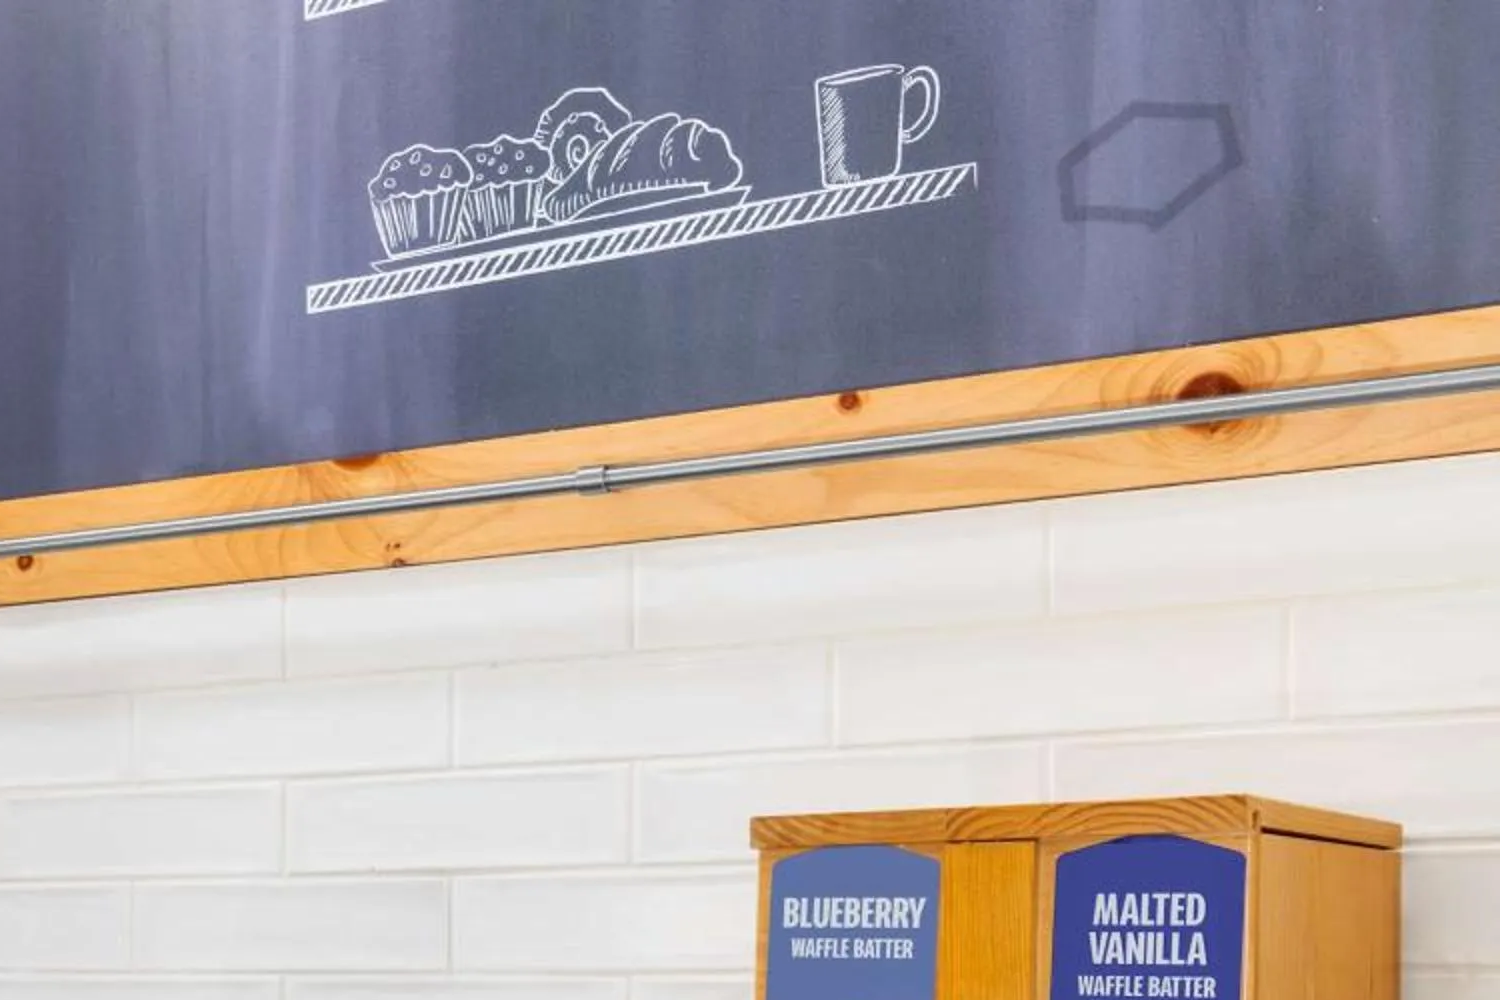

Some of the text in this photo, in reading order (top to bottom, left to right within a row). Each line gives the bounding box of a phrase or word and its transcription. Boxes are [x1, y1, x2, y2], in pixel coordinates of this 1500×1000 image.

[783, 897, 927, 929] BLUEBERRY
[1092, 892, 1207, 927] MALTED
[790, 937, 914, 960] WAFFLE BATTER
[1088, 931, 1208, 966] VANILLA
[1077, 975, 1217, 999] WAFFLE BATTER
